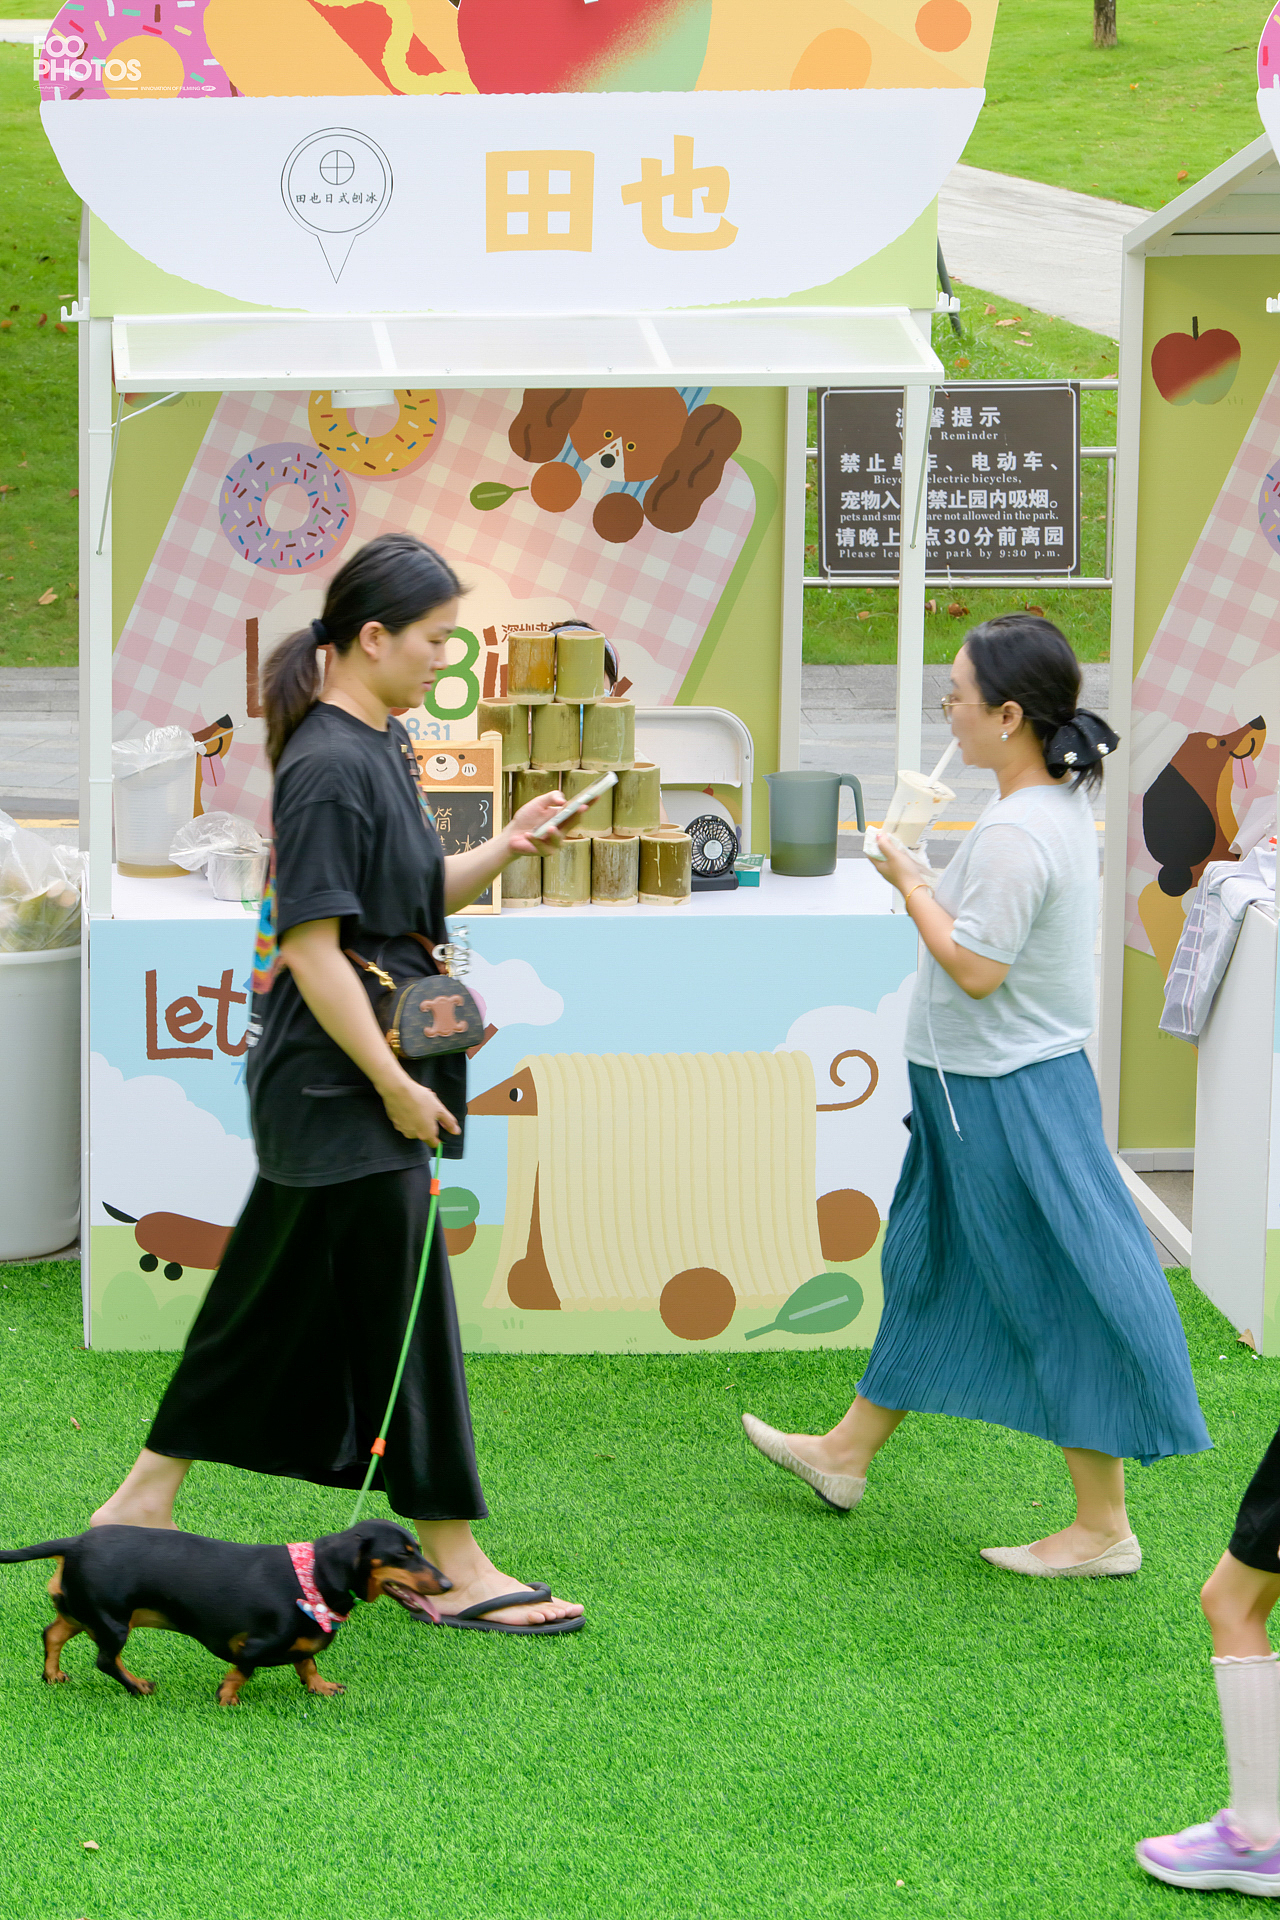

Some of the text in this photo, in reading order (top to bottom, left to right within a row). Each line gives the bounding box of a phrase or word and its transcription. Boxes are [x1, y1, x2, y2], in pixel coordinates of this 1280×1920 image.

[295, 191, 379, 205] 田也日式刨冰
[486, 134, 739, 253] 田也
[940, 430, 999, 441] Reminder
[927, 473, 970, 484] electric
[972, 473, 1022, 485] bicycles,
[840, 488, 1058, 511] 宠物入禁止园内吸烟。
[840, 513, 861, 524] pets
[862, 511, 881, 522] and
[926, 513, 943, 521] are
[944, 512, 960, 521] not
[962, 510, 1001, 521] allowed
[1002, 510, 1013, 521] in
[1014, 510, 1031, 520] the
[1032, 510, 1059, 523] park.
[835, 525, 1064, 547] 请晚上点30分前离园
[839, 547, 1060, 560] Please lea he park by 9:30 p.m.
